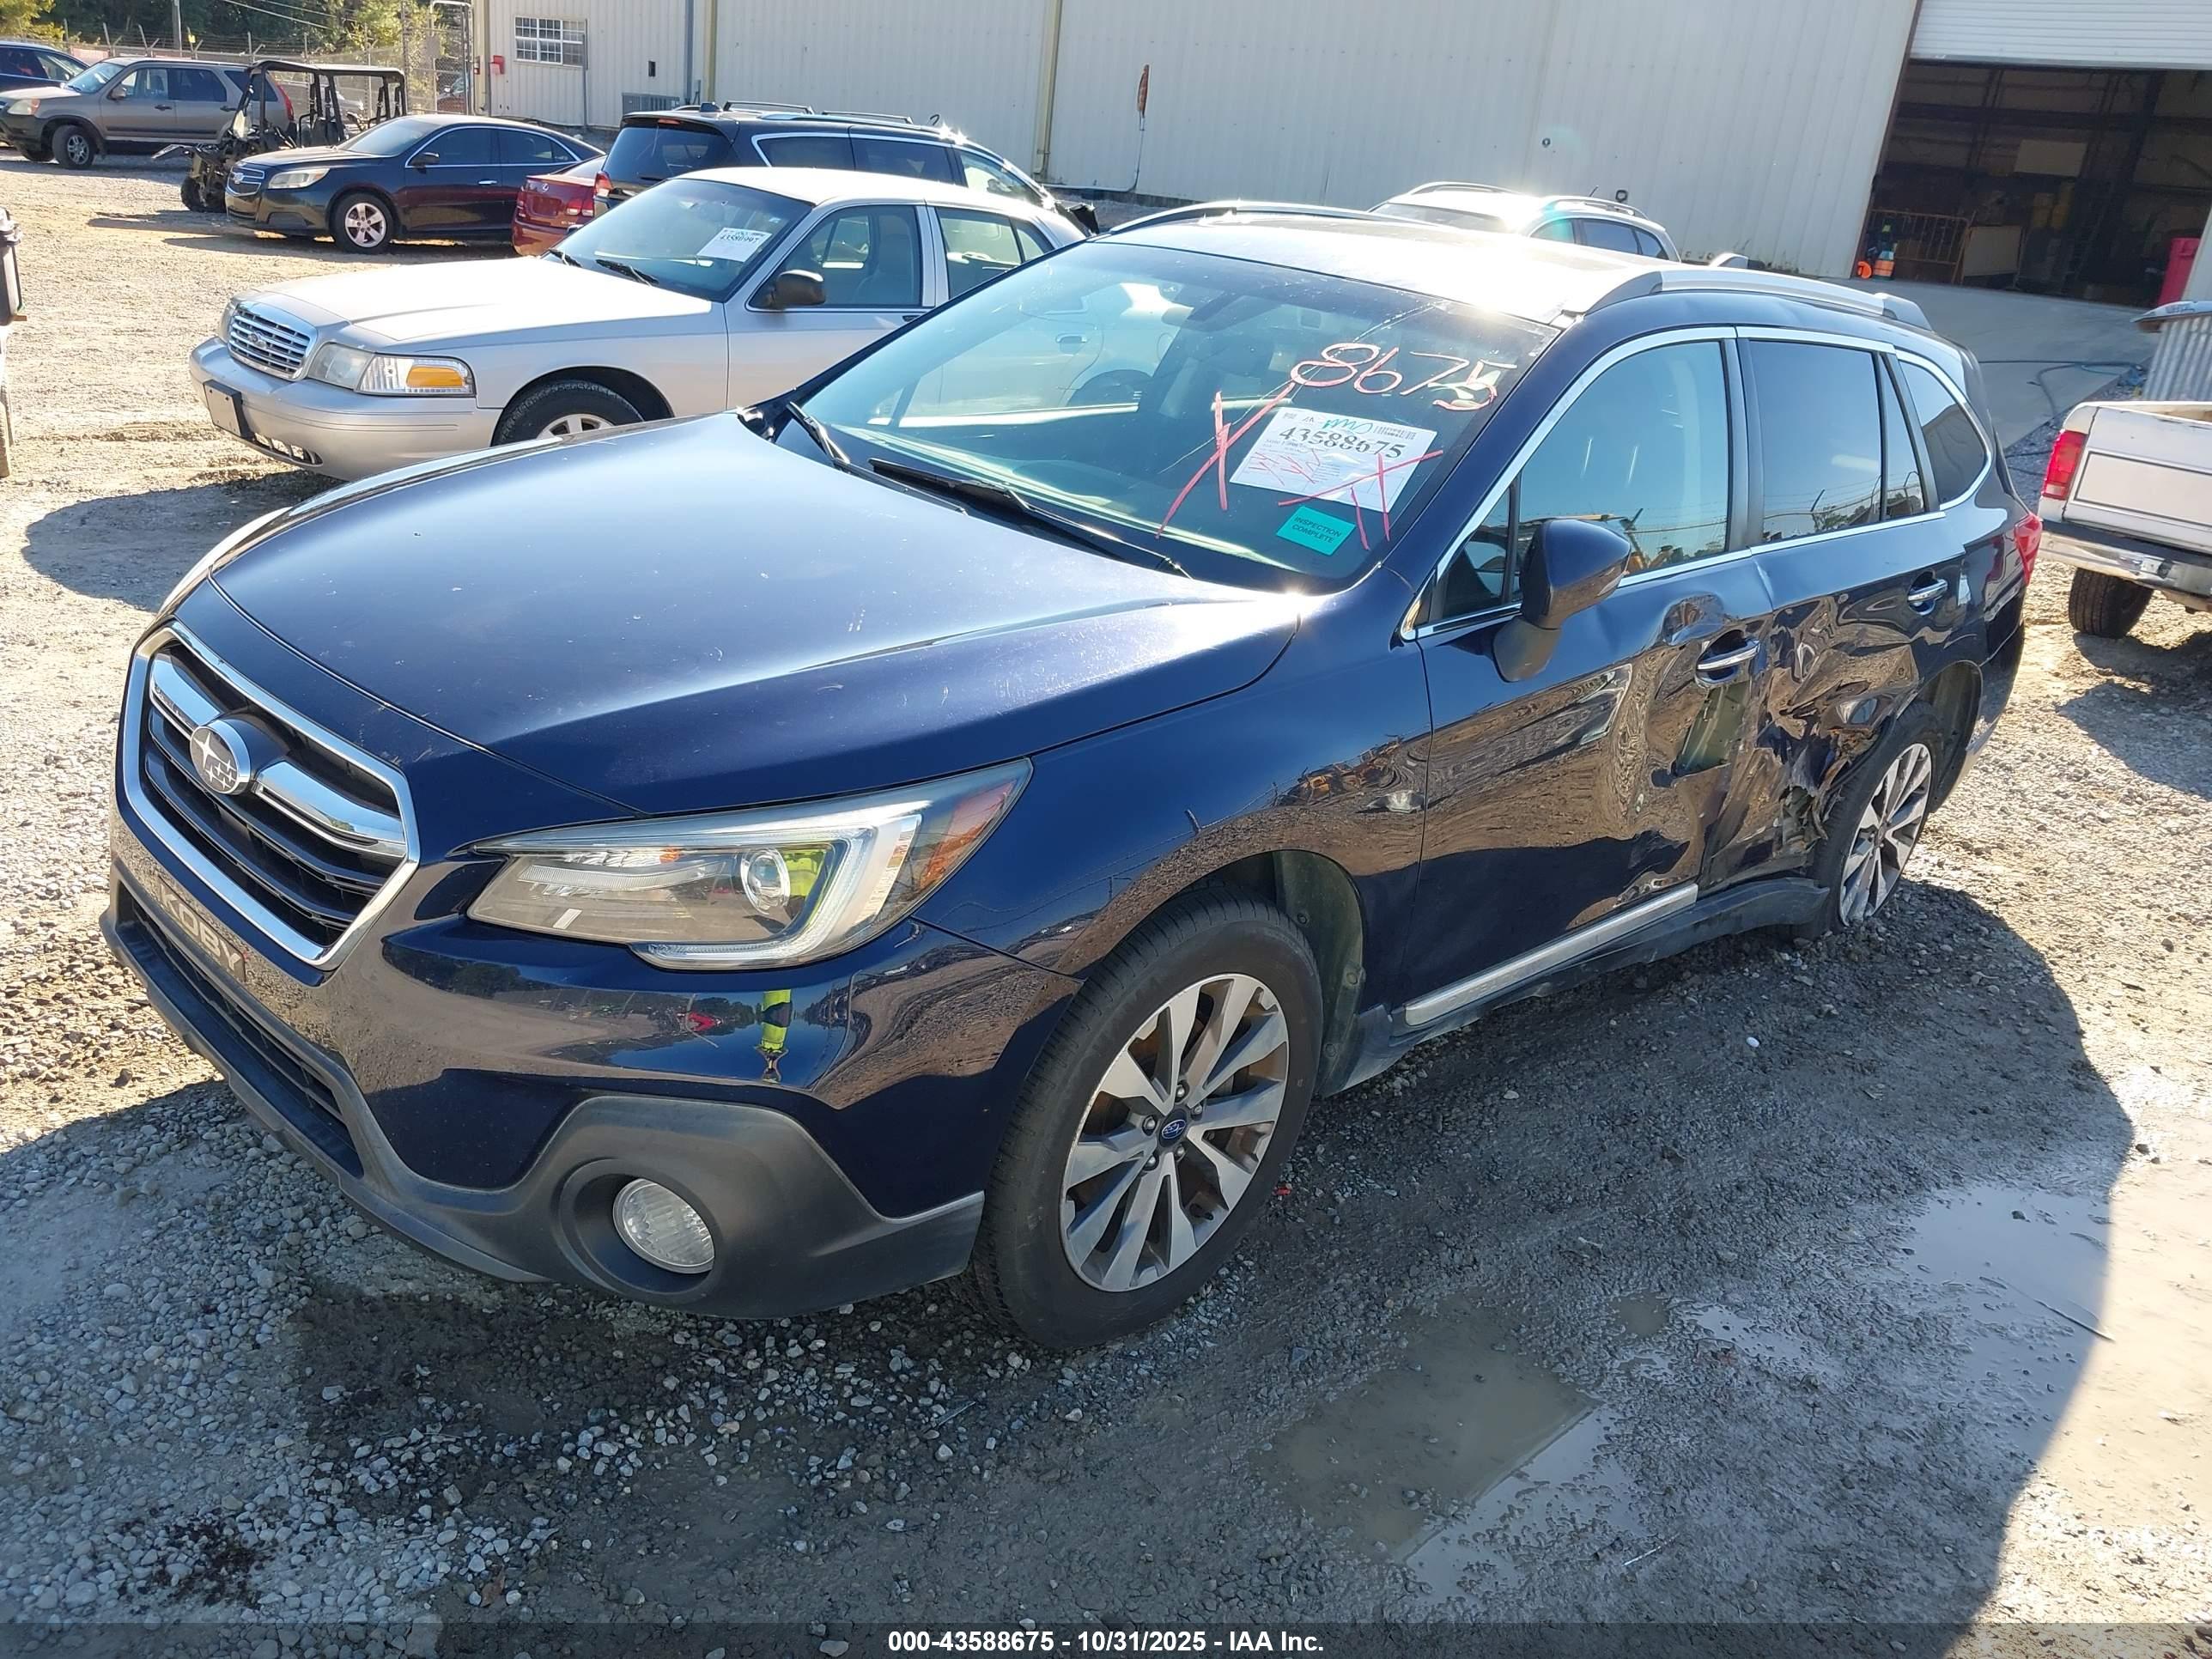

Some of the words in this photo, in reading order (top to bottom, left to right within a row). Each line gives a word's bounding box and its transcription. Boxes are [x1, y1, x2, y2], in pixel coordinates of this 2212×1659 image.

[1291, 343, 1518, 411] 8675
[1279, 426, 1407, 459] 43588675
[1291, 524, 1335, 544] COMPLETE
[1293, 515, 1342, 538] INSPECTION
[159, 883, 241, 971] KOBY
